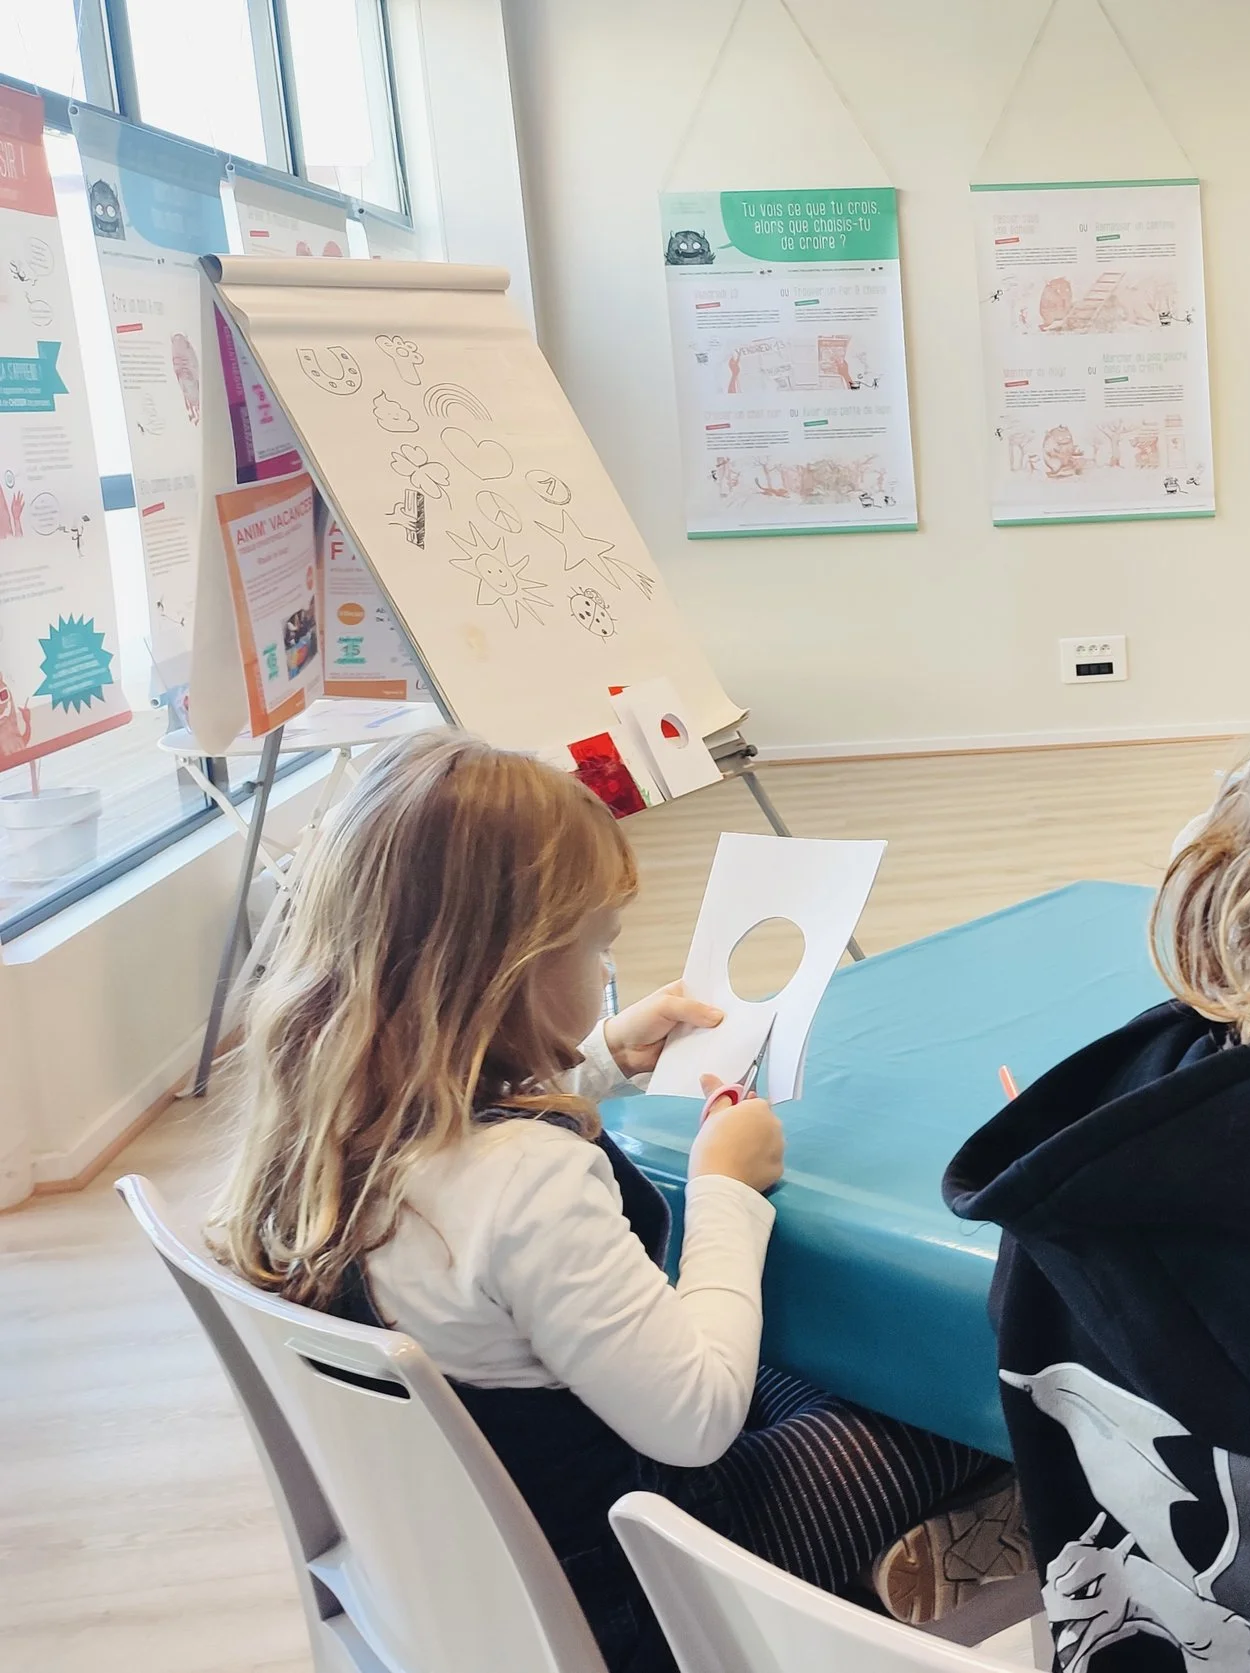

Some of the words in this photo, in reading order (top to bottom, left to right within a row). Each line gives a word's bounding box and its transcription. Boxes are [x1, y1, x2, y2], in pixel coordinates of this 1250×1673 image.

[742, 202, 755, 217] Tu
[760, 203, 783, 217] vois
[788, 203, 801, 217] ce
[806, 202, 826, 218] que
[831, 200, 843, 215] tu
[754, 220, 784, 234] alors
[789, 219, 809, 236] que
[813, 216, 871, 232] choisis-tu
[781, 236, 794, 250] de
[799, 235, 835, 250] croire
[839, 234, 846, 247] ?
[236, 520, 266, 545] ANIM'
[340, 645, 361, 656] 15
